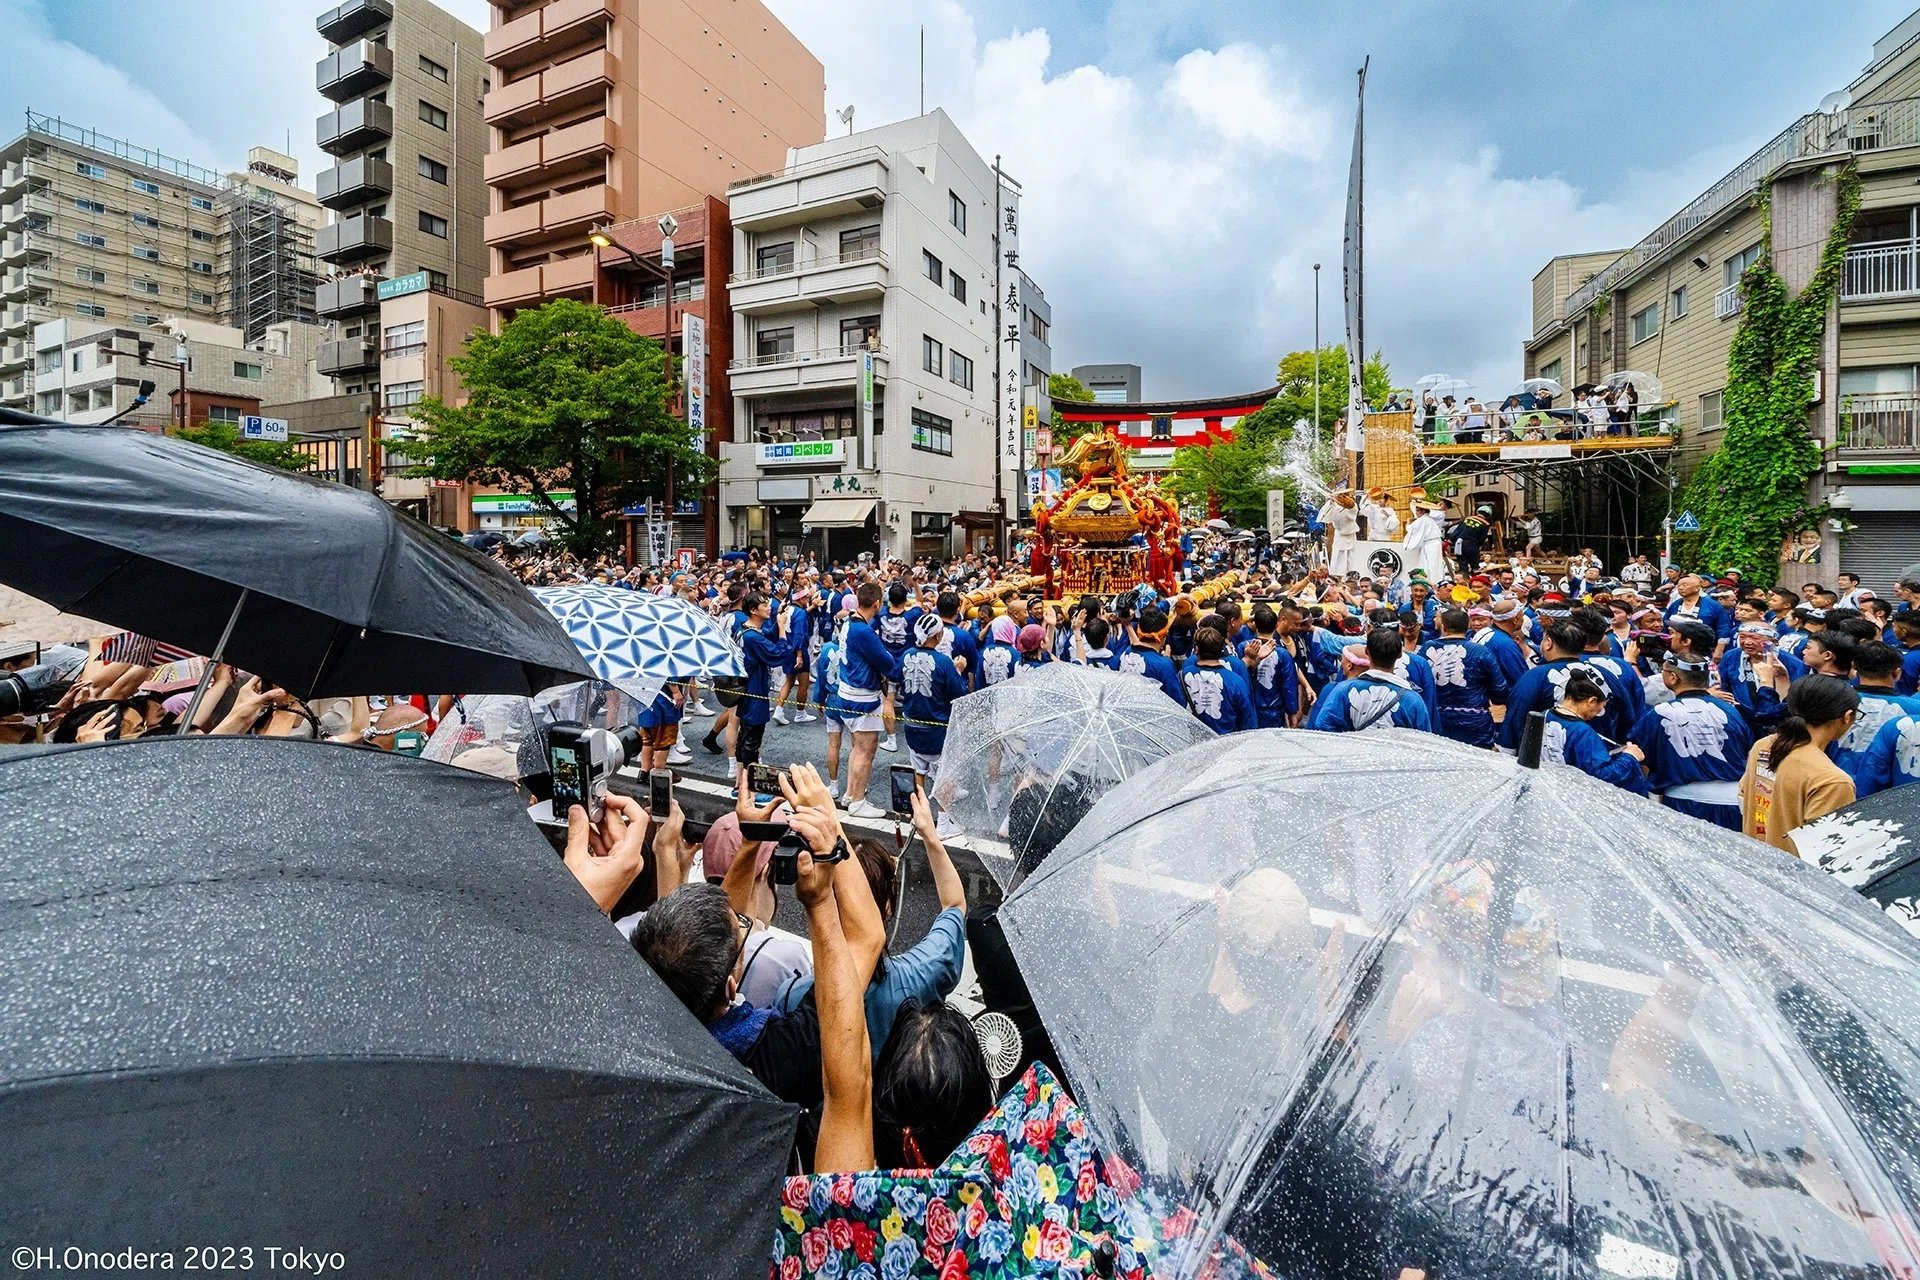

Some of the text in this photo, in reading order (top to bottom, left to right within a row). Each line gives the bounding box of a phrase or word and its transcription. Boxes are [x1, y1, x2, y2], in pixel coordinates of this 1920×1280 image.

[395, 276, 422, 292] カラカマ
[1004, 206, 1020, 352] 萬世泰平
[692, 321, 701, 385] 土地と建物
[251, 418, 259, 428] P
[265, 421, 285, 433] 60分
[1005, 368, 1017, 457] 令和元年吉辰
